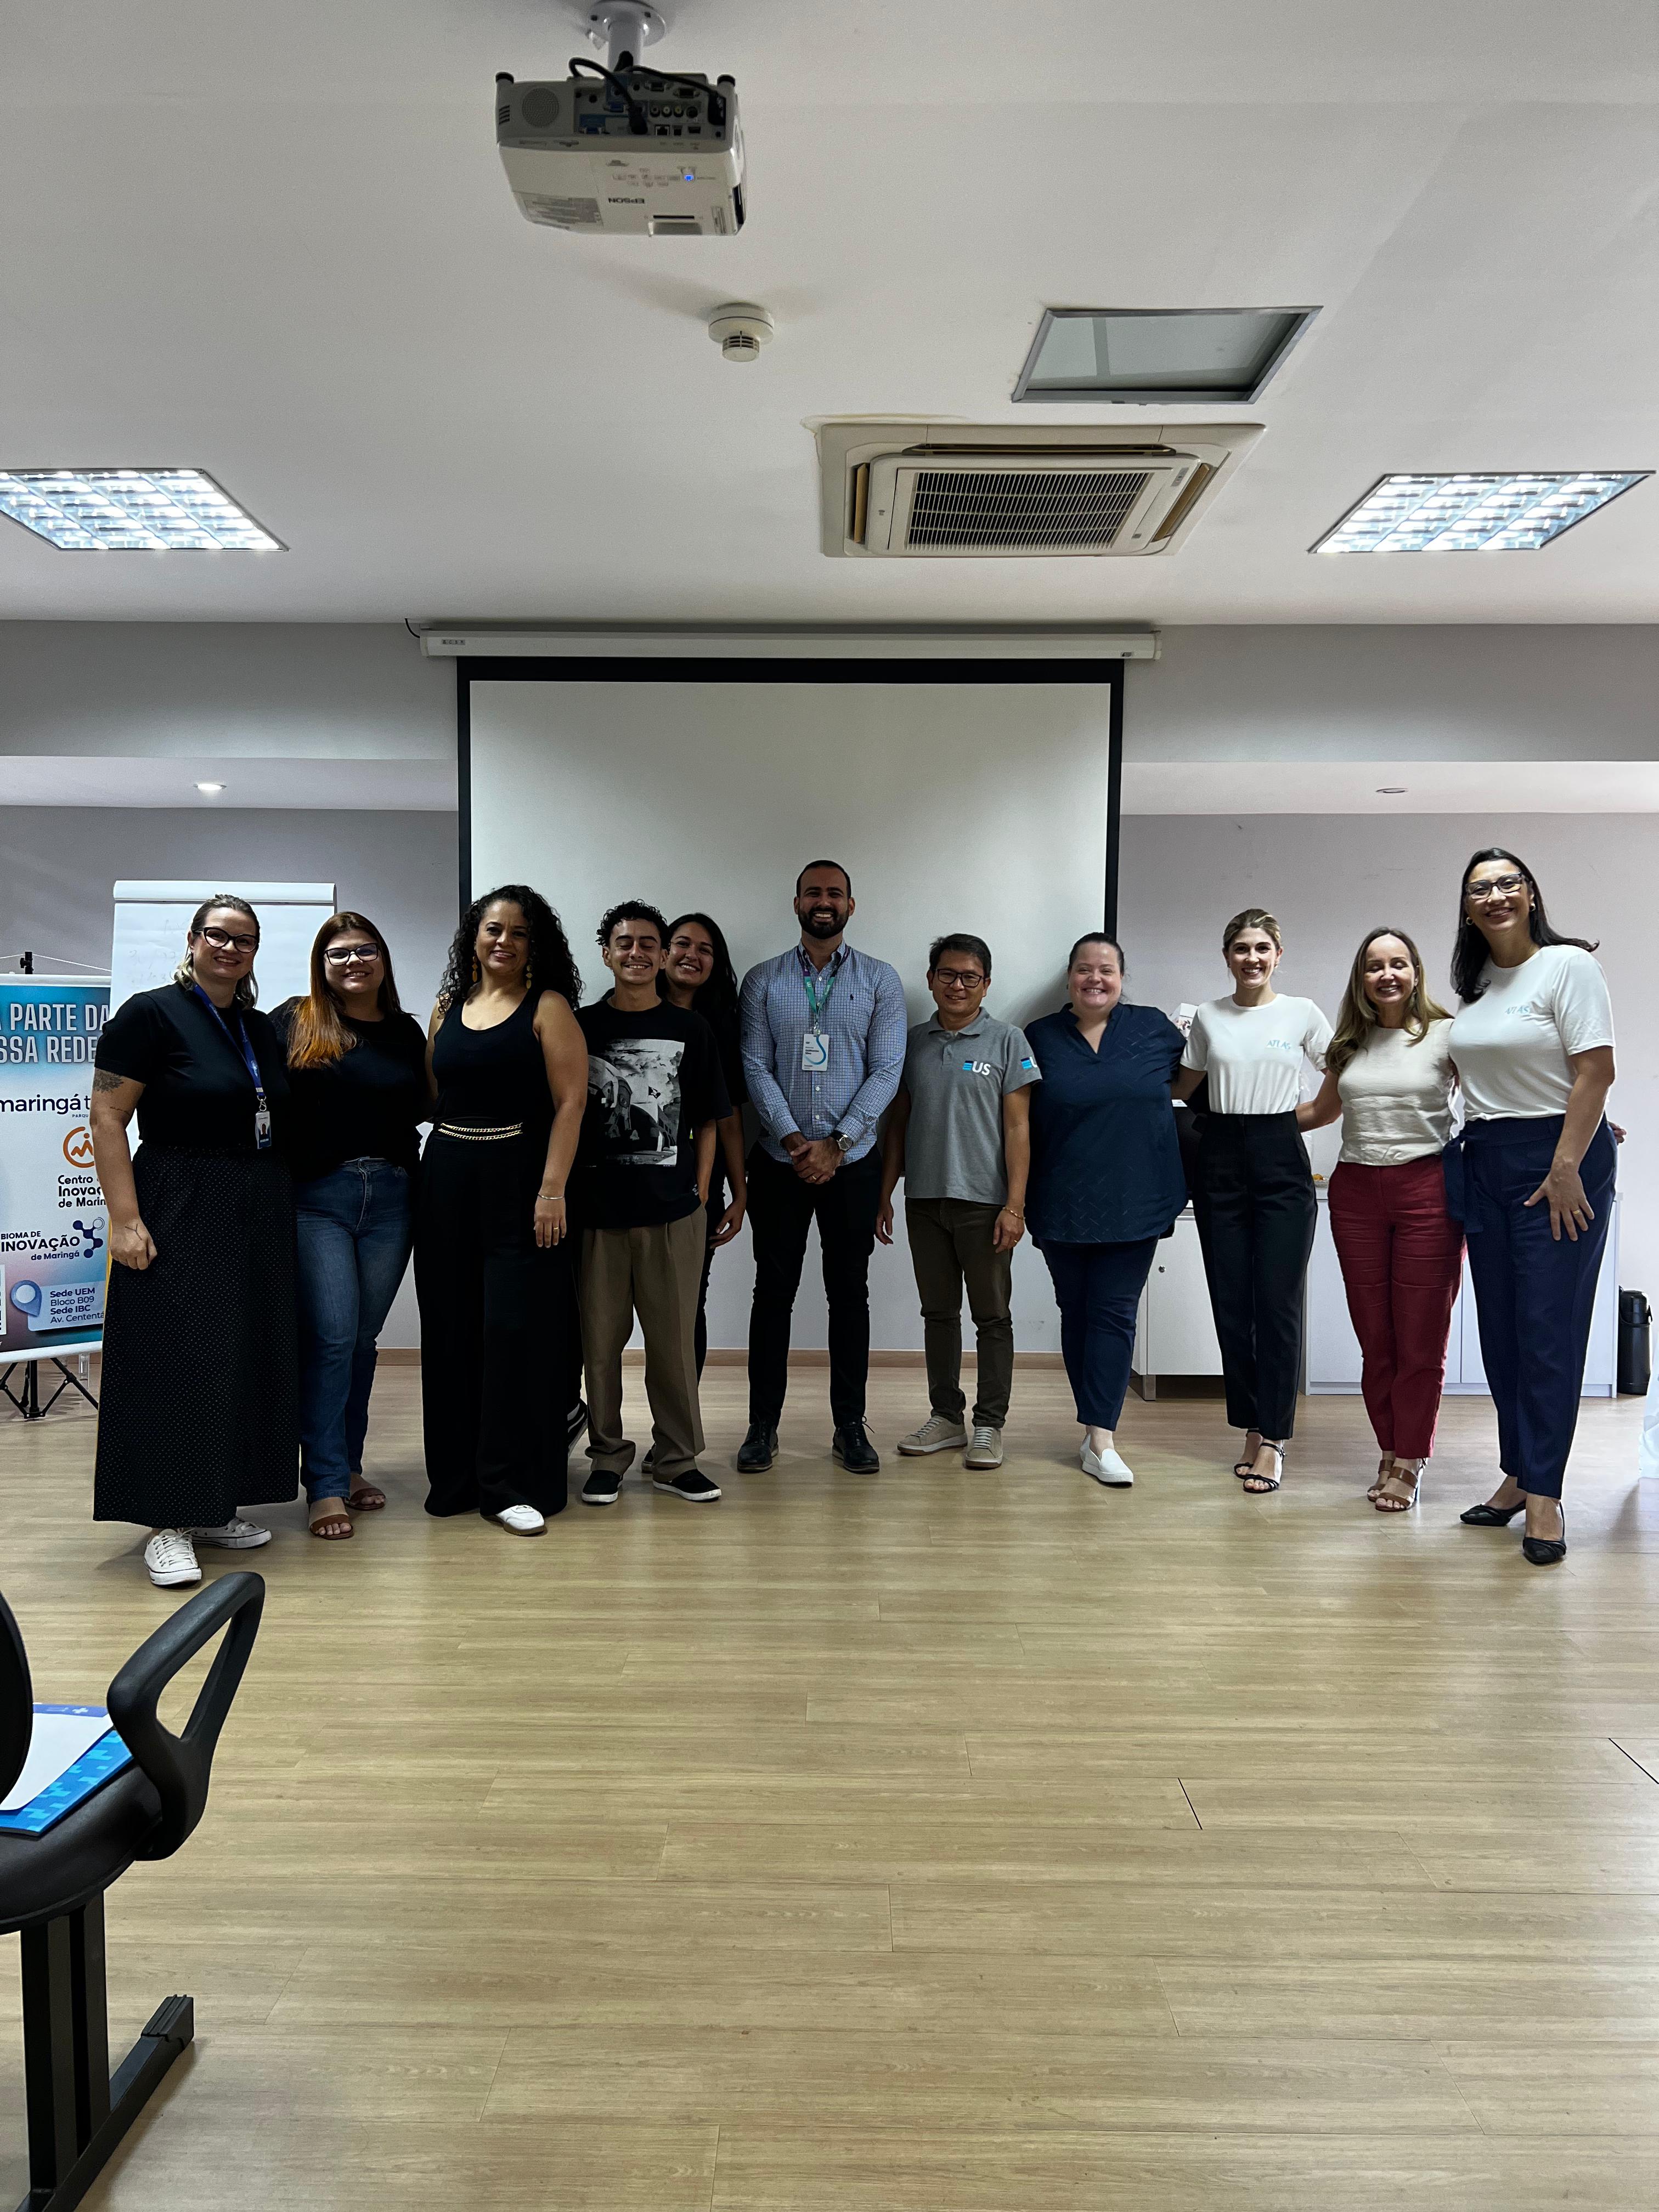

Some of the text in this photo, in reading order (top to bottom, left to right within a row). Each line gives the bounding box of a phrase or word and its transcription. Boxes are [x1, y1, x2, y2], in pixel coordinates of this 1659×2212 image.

[10, 1003, 110, 1031] PARTE DA
[47, 1036, 98, 1063] REDE
[1266, 1040, 1291, 1049] ATLAS
[58, 1175, 93, 1184] Centro
[58, 1197, 106, 1208] de Marin
[1, 1232, 29, 1240] BIOMA
[1, 1234, 80, 1252] INOVAÇÃO
[44, 1250, 80, 1260] Maringá
[50, 1287, 95, 1298] Sede UEM
[50, 1295, 94, 1307] Bloco B09
[50, 1304, 91, 1315] Sede IBC
